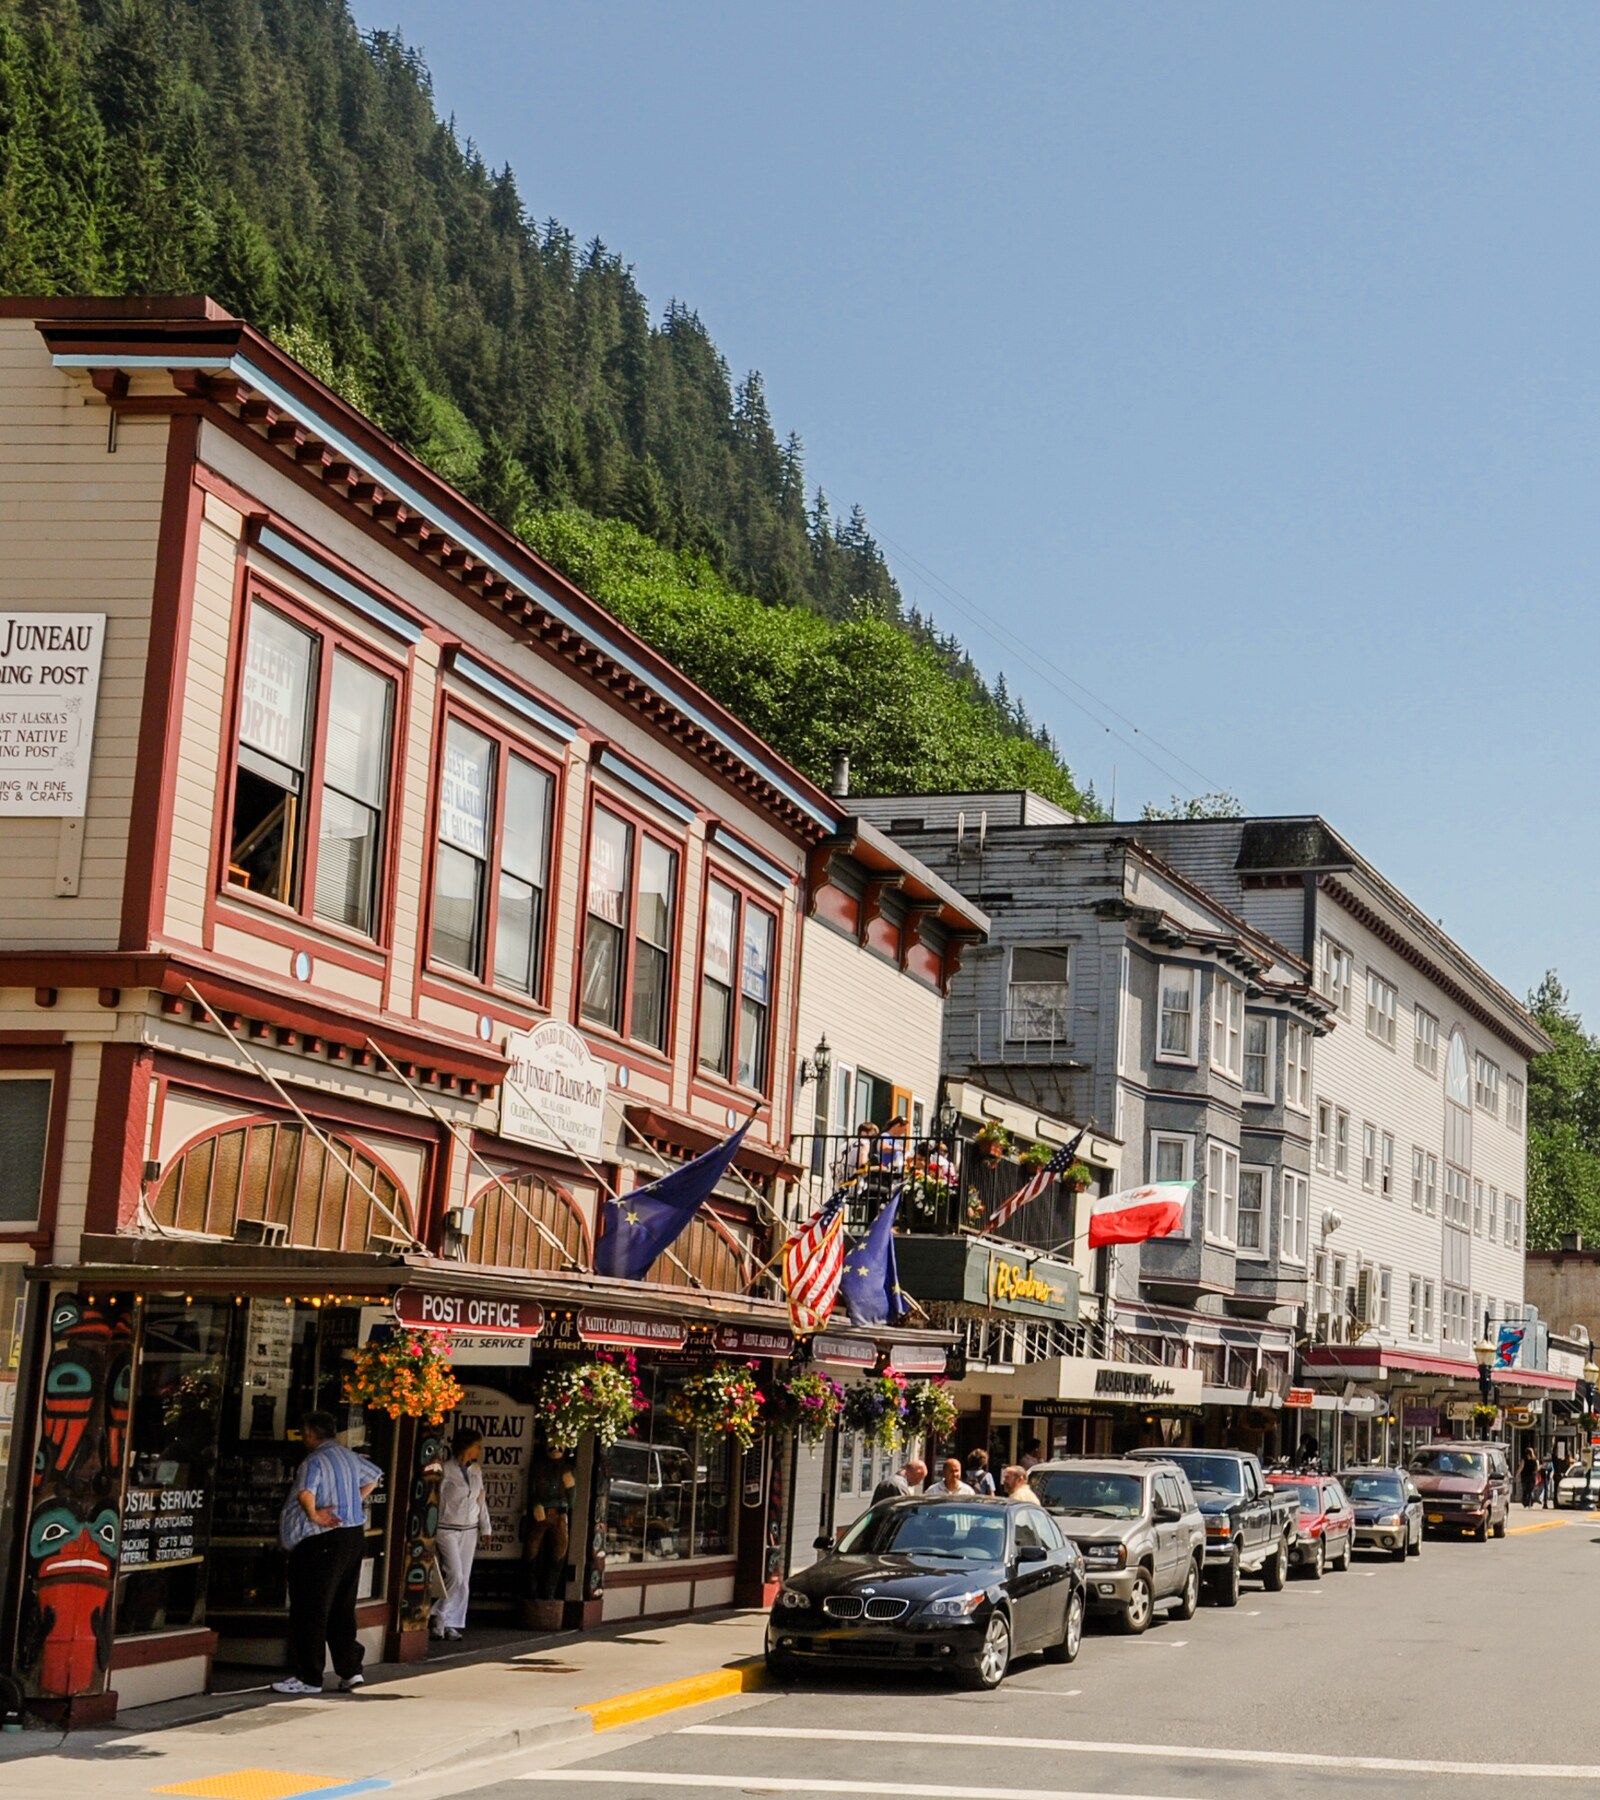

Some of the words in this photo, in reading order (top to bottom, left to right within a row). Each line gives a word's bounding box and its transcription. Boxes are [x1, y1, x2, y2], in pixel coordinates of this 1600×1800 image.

[1, 620, 93, 657] JUNEAU
[0, 666, 33, 684] ING
[39, 666, 89, 684] POST
[245, 675, 257, 693] OF
[260, 683, 279, 705] THE
[0, 712, 18, 724] AST
[20, 712, 67, 724] ALASKA'S
[240, 695, 288, 757] ORTH
[16, 730, 68, 743] NATIVE
[0, 746, 20, 757] ING
[25, 746, 58, 758] POST
[0, 781, 21, 790] ING
[27, 781, 38, 790] IN
[44, 781, 66, 791] FINE
[0, 791, 9, 801] TS
[15, 792, 23, 801] &
[30, 791, 73, 802] CRAFTS
[589, 880, 618, 922] ORTH
[422, 1294, 464, 1323] POST
[468, 1300, 520, 1328] OFFICE
[543, 1320, 557, 1336] RY
[560, 1321, 574, 1337] OF
[585, 1317, 607, 1332] NATIVE
[608, 1319, 630, 1334] CARVED
[478, 1339, 526, 1349] SERVICE
[554, 1338, 581, 1350] Finest
[689, 1335, 712, 1345] radi
[447, 1410, 526, 1442] JUNEAU
[484, 1446, 523, 1466] POST
[483, 1472, 513, 1480] ASKA'S
[484, 1482, 519, 1495] TIVE
[160, 1490, 204, 1510] SERVICE
[485, 1495, 515, 1508] OST
[123, 1519, 150, 1531] STAMPS
[154, 1515, 193, 1528] POSTCARDS
[491, 1524, 515, 1532] AFTS
[159, 1537, 178, 1548] GIFTS
[179, 1535, 193, 1546] AND
[155, 1547, 194, 1561] STATIONERY
